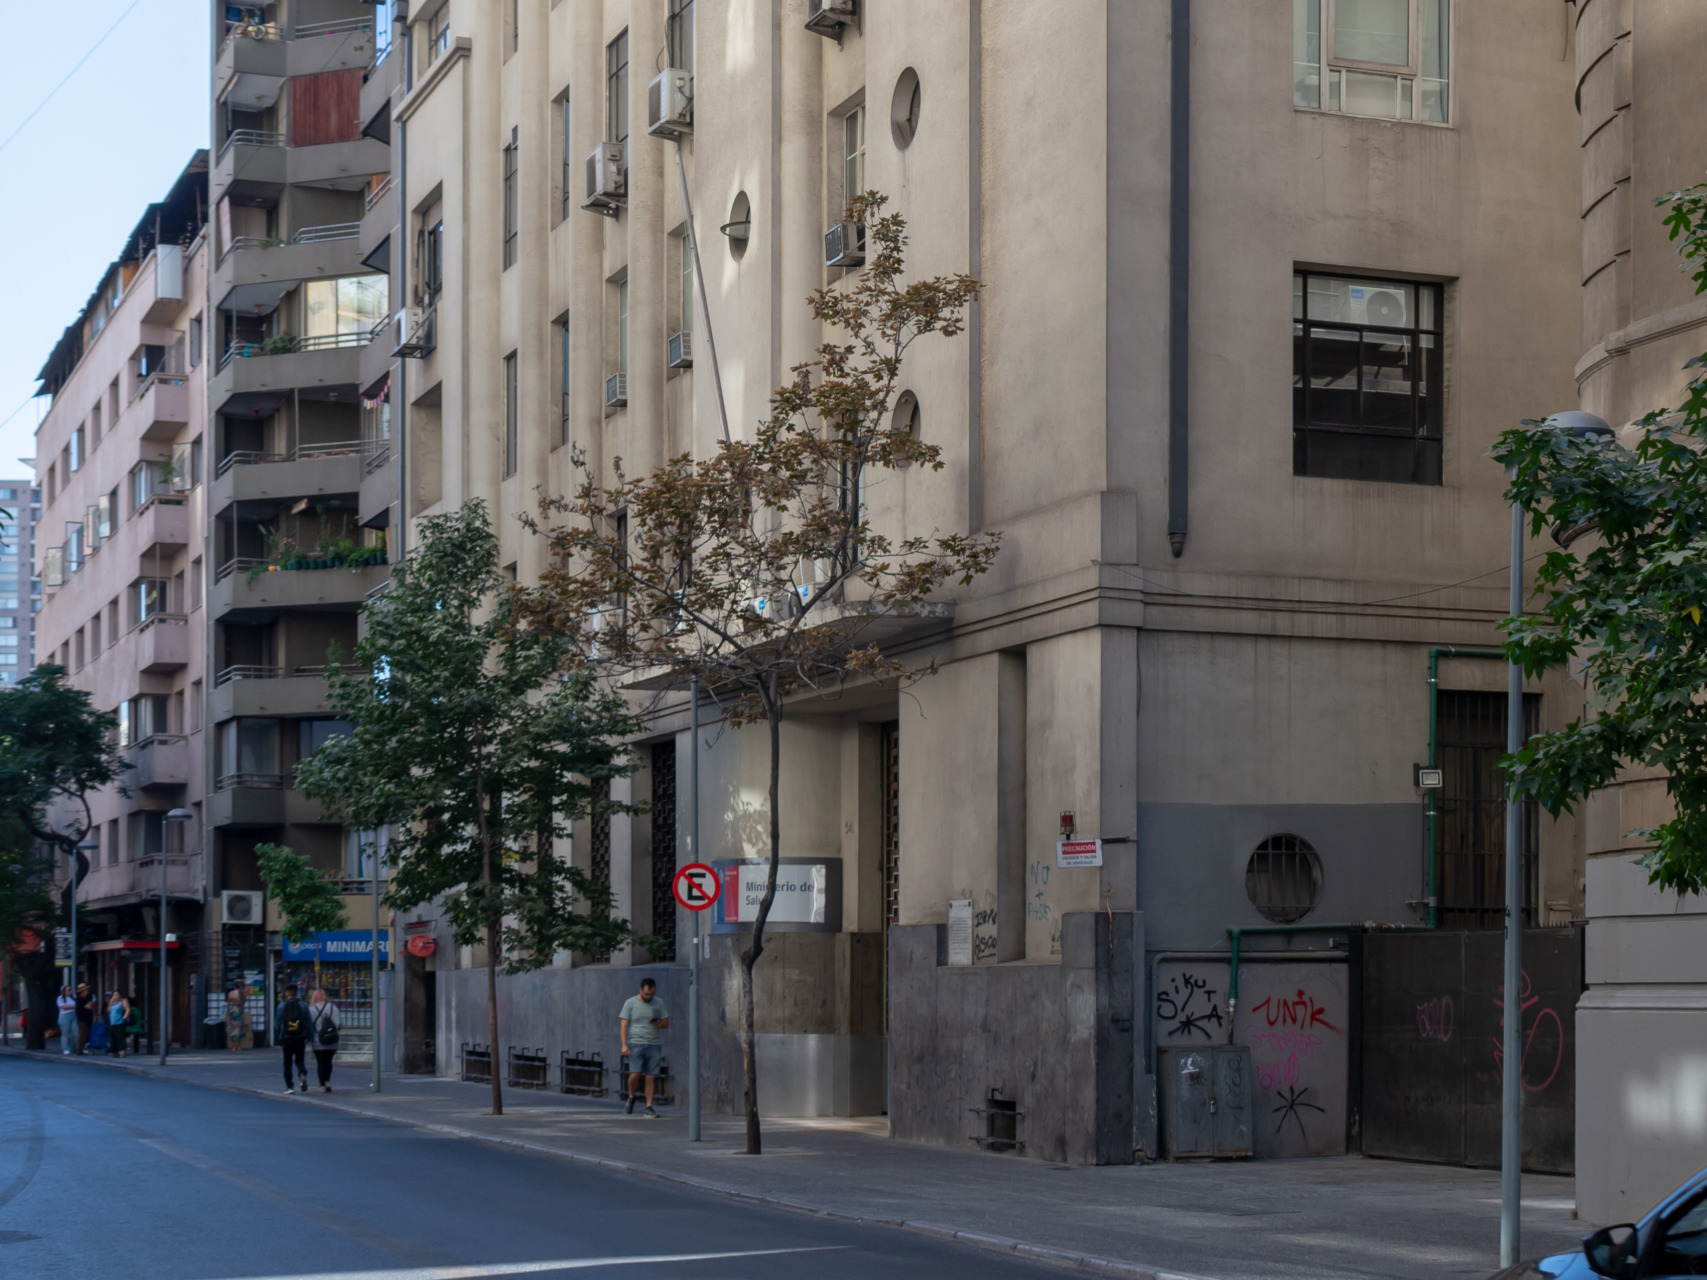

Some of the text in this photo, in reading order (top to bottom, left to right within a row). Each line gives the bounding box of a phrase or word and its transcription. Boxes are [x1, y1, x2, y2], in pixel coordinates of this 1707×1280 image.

[687, 873, 706, 901] E
[745, 881, 815, 893] Minierio de
